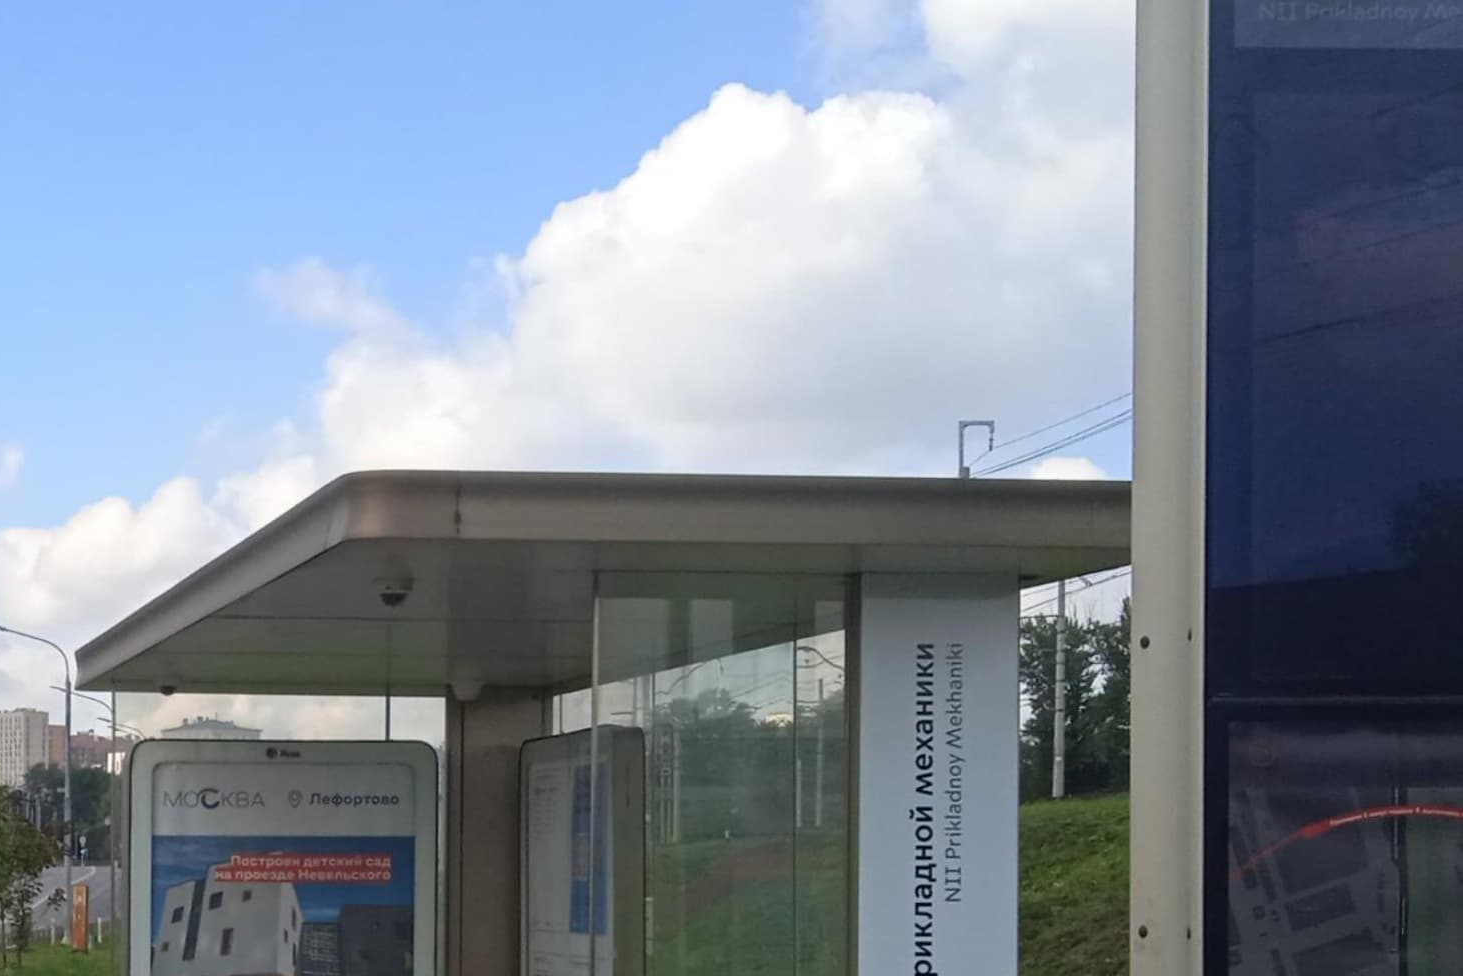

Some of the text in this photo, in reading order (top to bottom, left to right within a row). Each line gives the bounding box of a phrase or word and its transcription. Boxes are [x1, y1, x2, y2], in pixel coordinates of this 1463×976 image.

[914, 642, 935, 796] механики
[944, 642, 966, 902] NII Prikladnoy Mekhaniki
[162, 787, 265, 809] МОСКВА
[309, 791, 400, 809] Лефортово
[230, 855, 391, 869] Построен детский сад
[214, 869, 391, 882] на проезде Невельского
